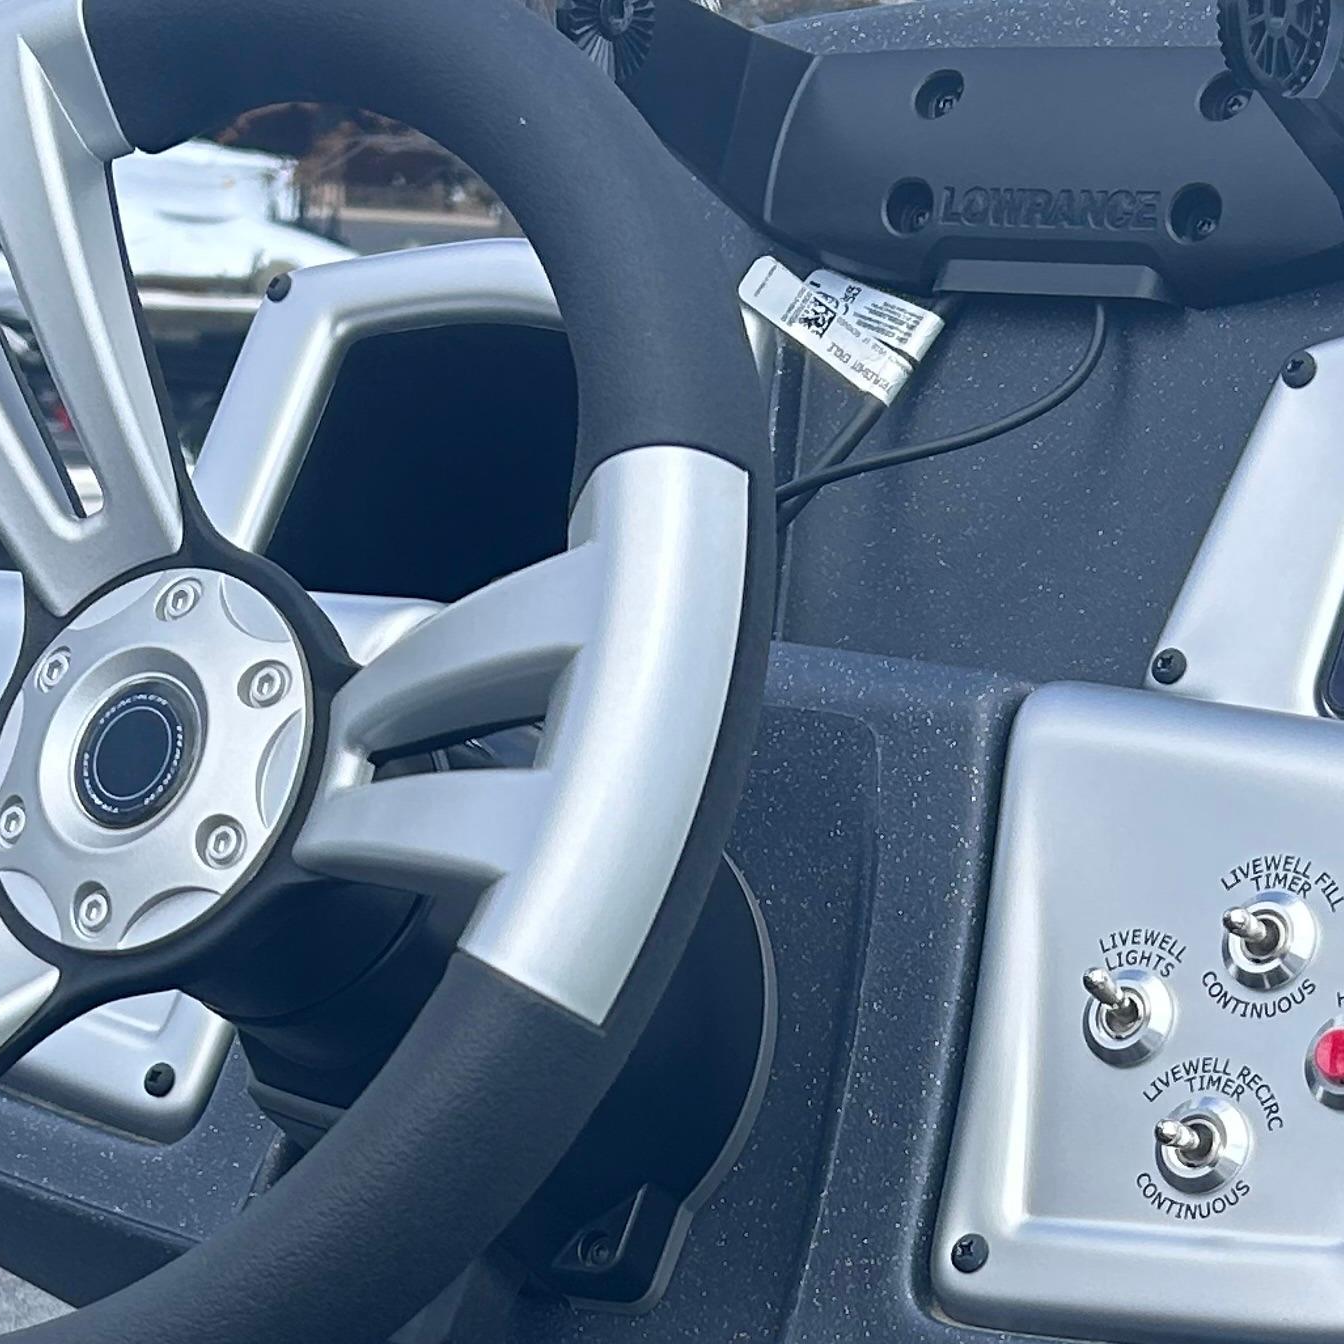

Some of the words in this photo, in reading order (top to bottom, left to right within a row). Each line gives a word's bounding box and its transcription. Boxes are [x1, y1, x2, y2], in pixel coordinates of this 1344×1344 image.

[938, 185, 1162, 233] LOWRANCE
[1220, 854, 1312, 891] LIVEWELL
[1250, 872, 1312, 900] TIMER
[1099, 928, 1187, 963] LIVEWELL
[1104, 949, 1175, 978] LIGHTS
[1201, 970, 1316, 1020] CONTINUOUS
[1142, 1056, 1232, 1103] LIVEWELL
[1236, 1065, 1284, 1132] RECIRC
[1183, 1074, 1246, 1103] TIMER
[1136, 1172, 1251, 1221] CONTINUOUS
